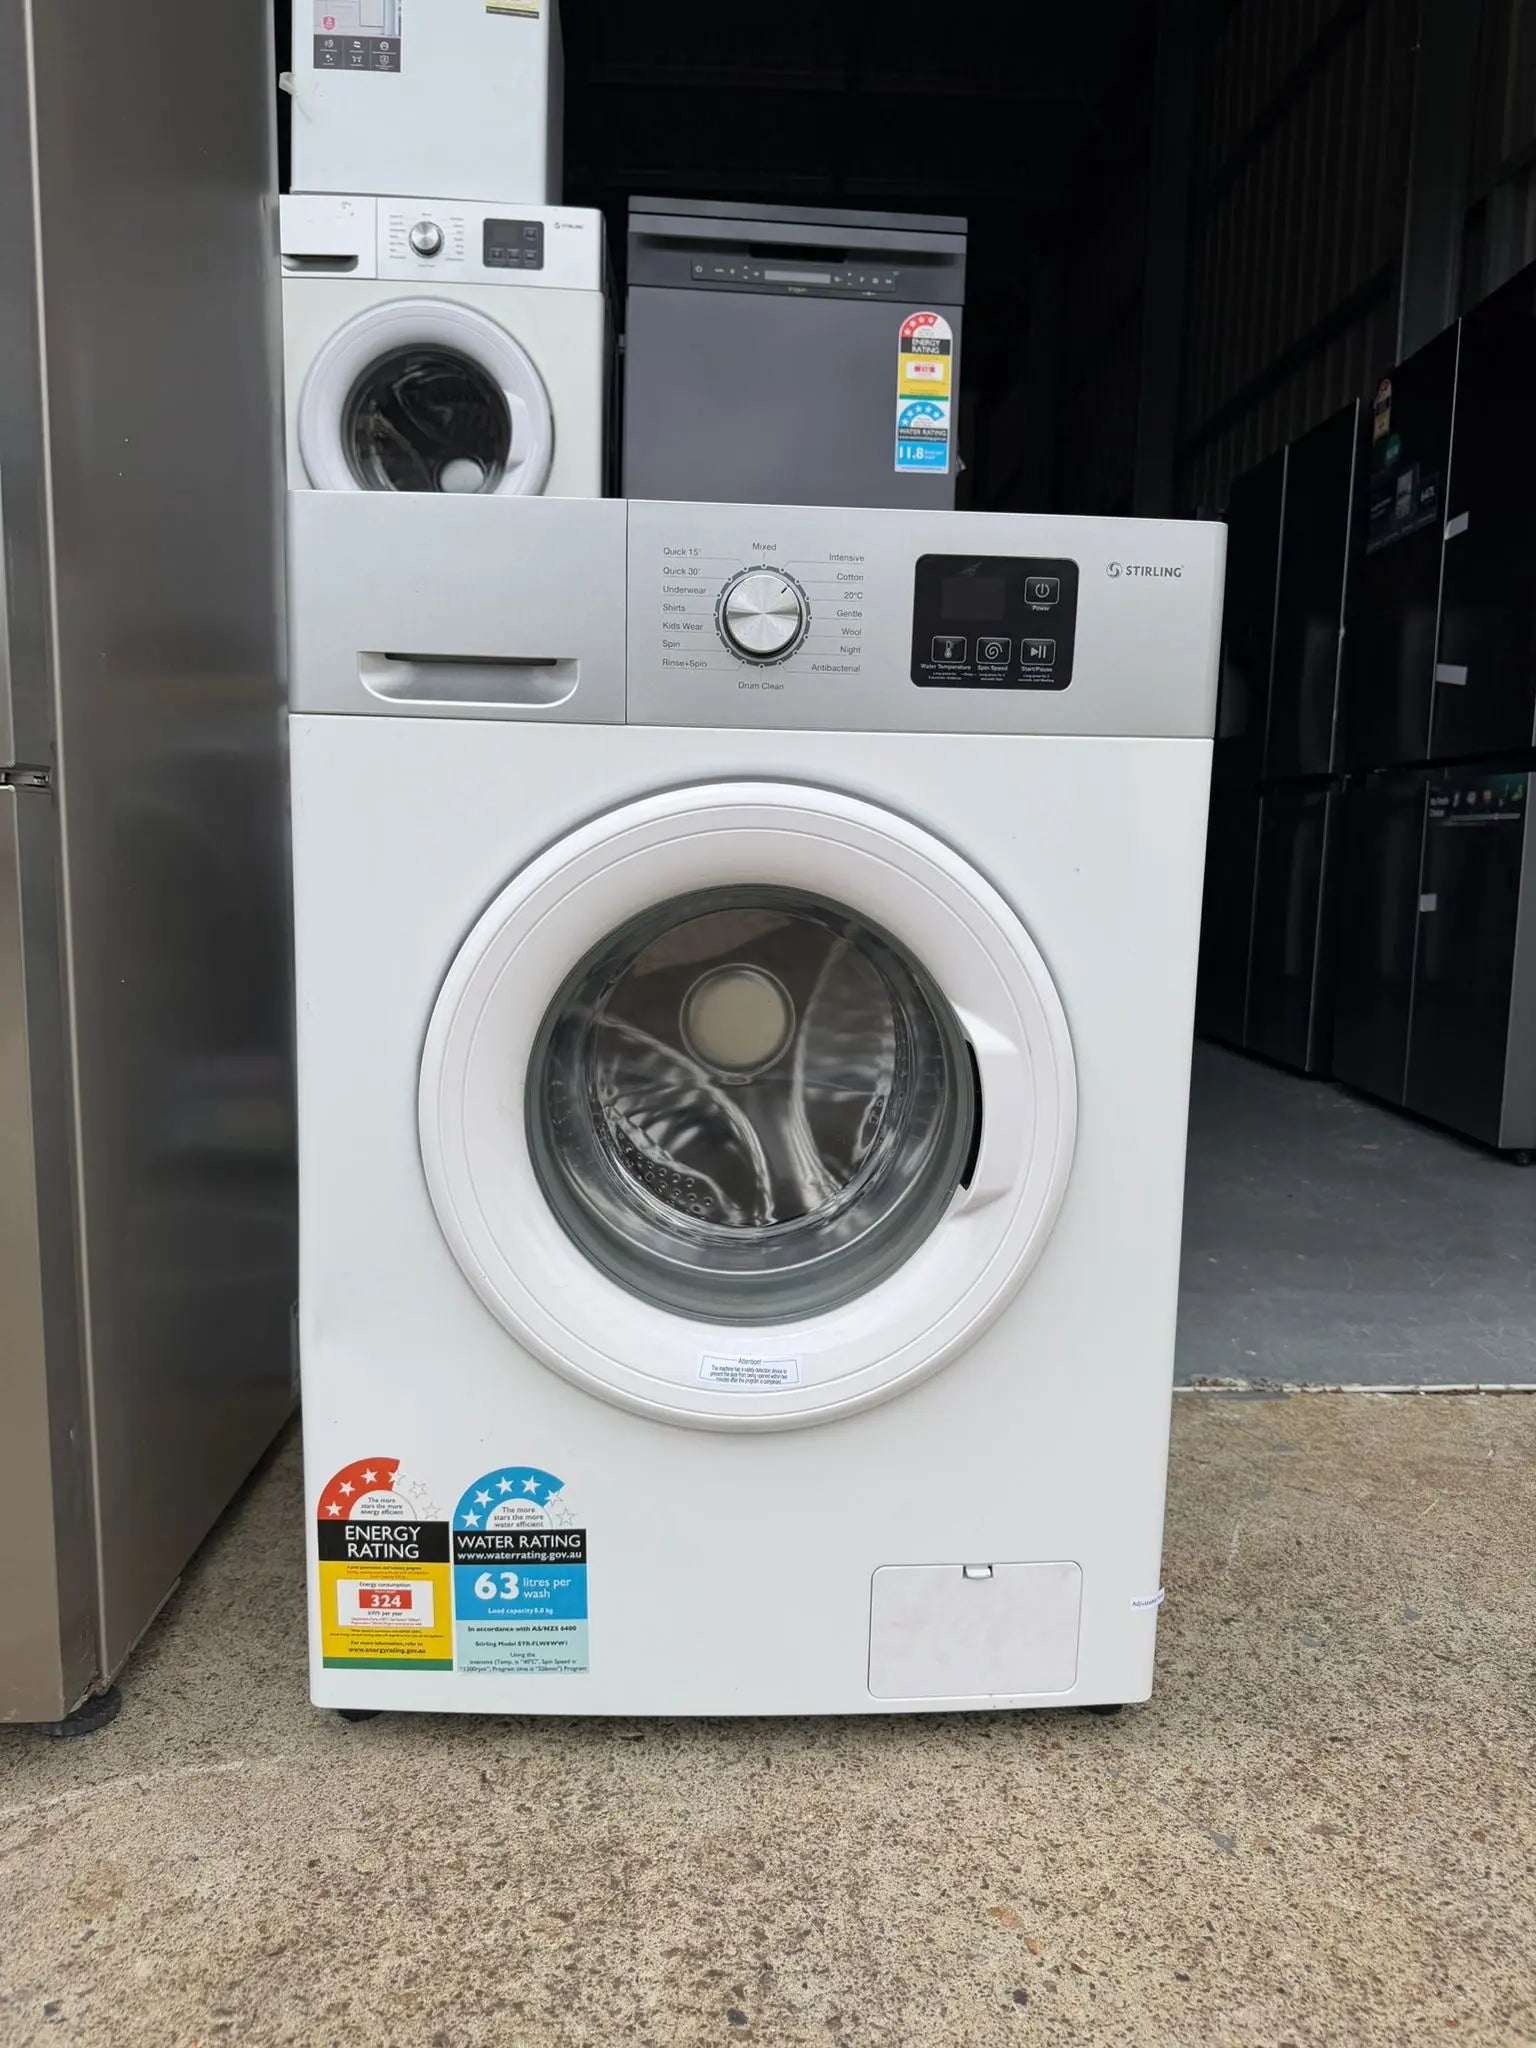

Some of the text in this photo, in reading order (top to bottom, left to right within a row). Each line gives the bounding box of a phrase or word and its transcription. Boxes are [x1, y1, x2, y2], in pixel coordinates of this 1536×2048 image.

[912, 338, 941, 347] ENERGY
[912, 346, 940, 354] RATING
[900, 428, 946, 437] WATER RATING
[899, 446, 925, 460] 11.8
[752, 542, 777, 551] Mixed
[663, 547, 687, 556] Quick
[829, 553, 864, 562] Intensive
[663, 566, 686, 576] Quick
[1125, 565, 1182, 578] STIRLING
[836, 573, 864, 581] Cotton
[662, 586, 707, 594] Underwear
[662, 604, 686, 612] Shirts
[836, 609, 863, 618] Gentle
[662, 622, 704, 631] Kids Wear
[841, 628, 862, 636] Wool
[662, 640, 681, 648] Spin
[840, 645, 861, 656] Night
[662, 659, 707, 668] Rinse+Spin
[811, 663, 861, 672] Antibacterial
[738, 681, 784, 690] Drum Clean
[516, 1520, 544, 1528] efficient
[345, 1525, 421, 1541] ENERGY
[457, 1534, 581, 1549] WATER RATING
[347, 1543, 420, 1559] RATING
[457, 1550, 582, 1561] www.waterrating.gov.au
[474, 1571, 520, 1600] 63
[523, 1578, 572, 1589] litres per
[523, 1588, 551, 1599] wash
[371, 1594, 402, 1607] 324
[506, 1607, 533, 1615] capacity
[545, 1607, 553, 1615] kg
